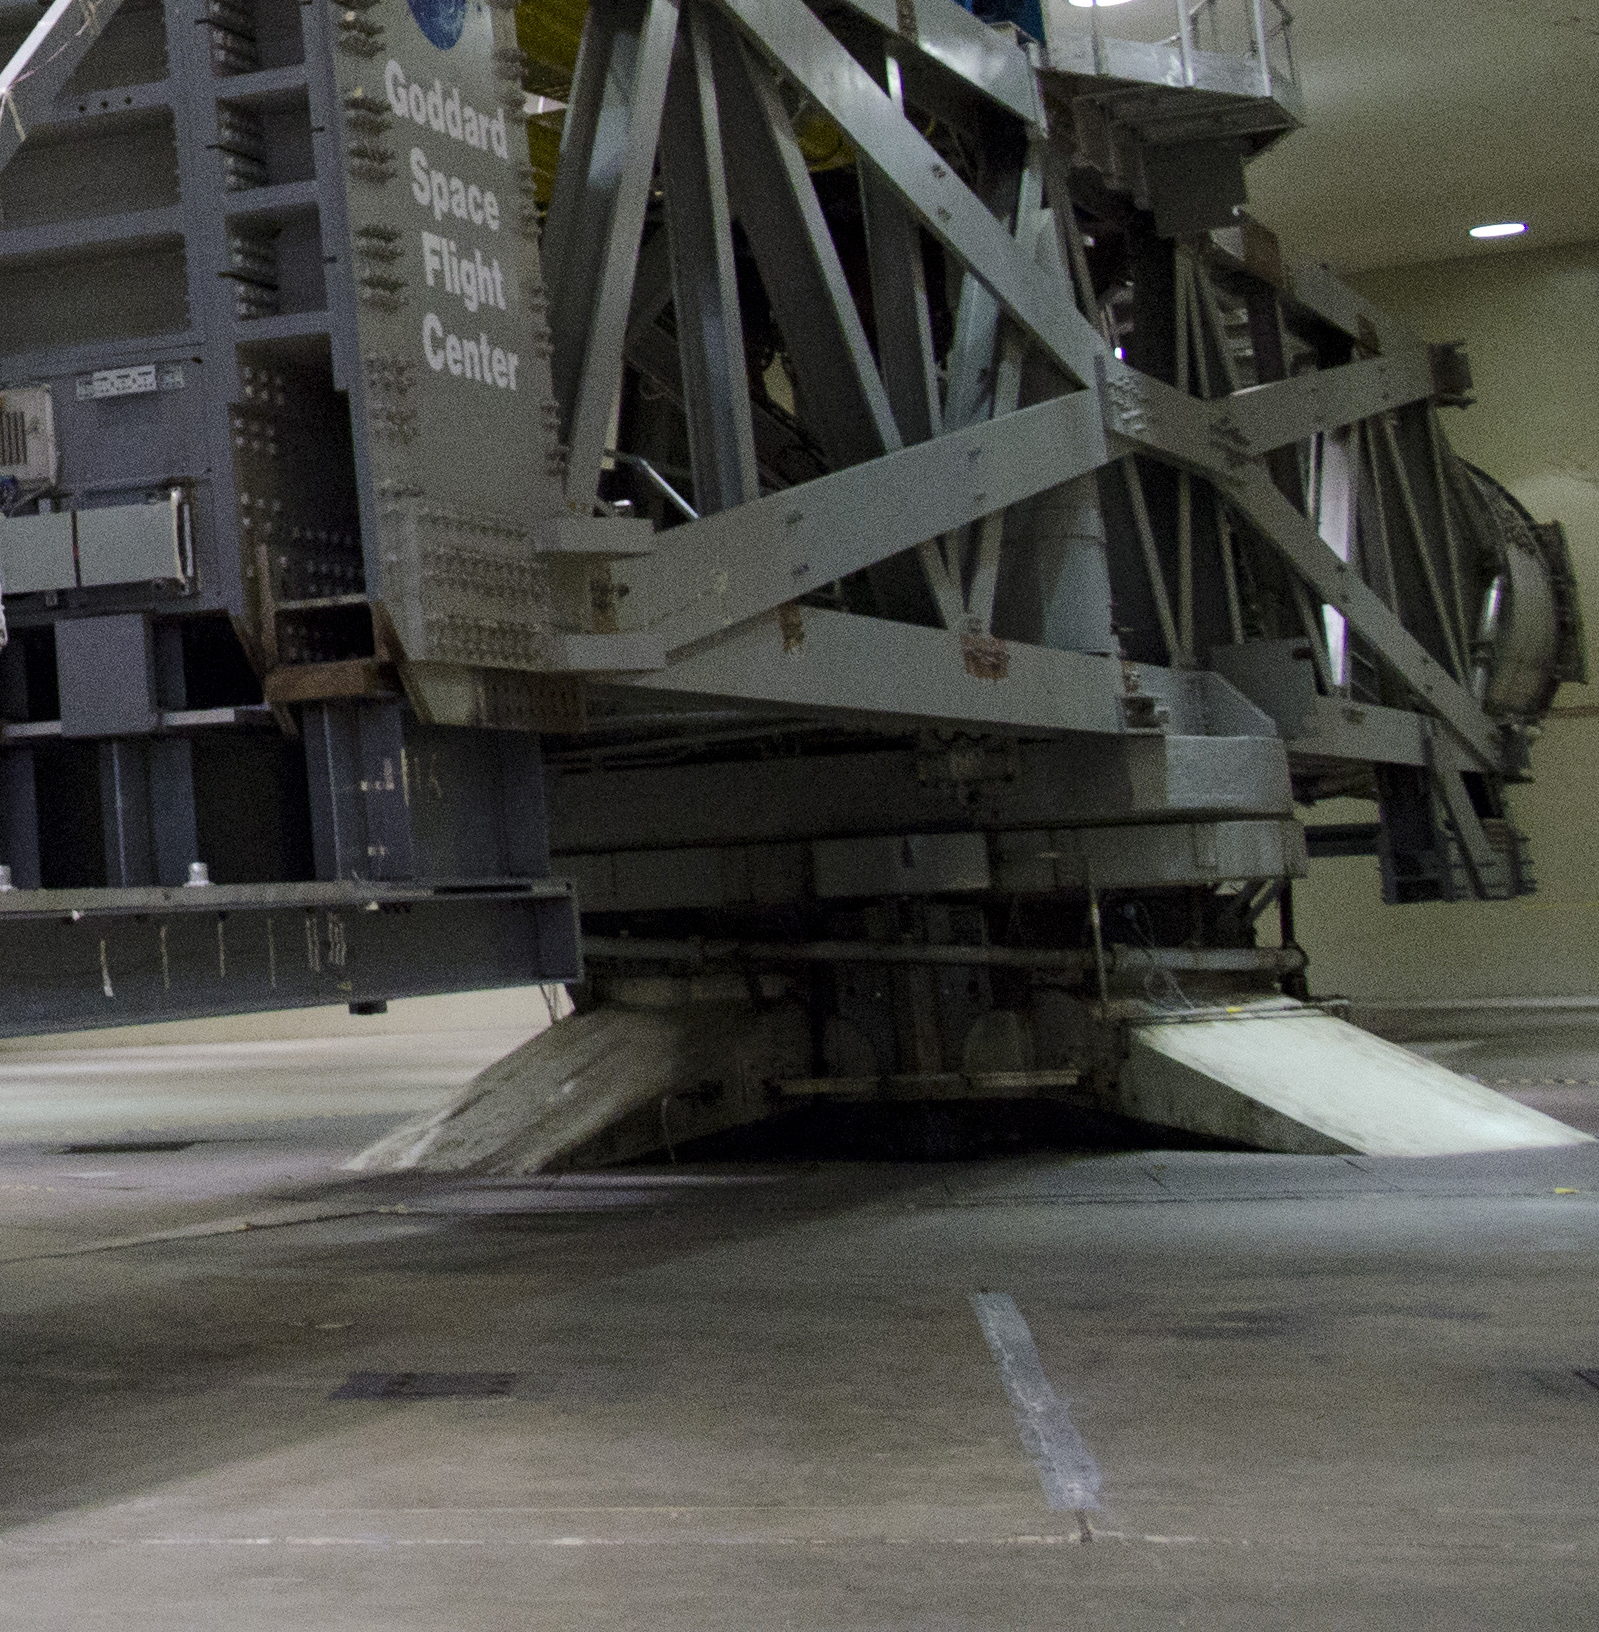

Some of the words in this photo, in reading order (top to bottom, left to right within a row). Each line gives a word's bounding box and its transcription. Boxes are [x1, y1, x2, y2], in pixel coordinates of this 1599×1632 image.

[385, 59, 508, 160] Goddard
[409, 146, 500, 231] Space
[421, 231, 506, 312] Flight
[422, 312, 519, 391] Center
